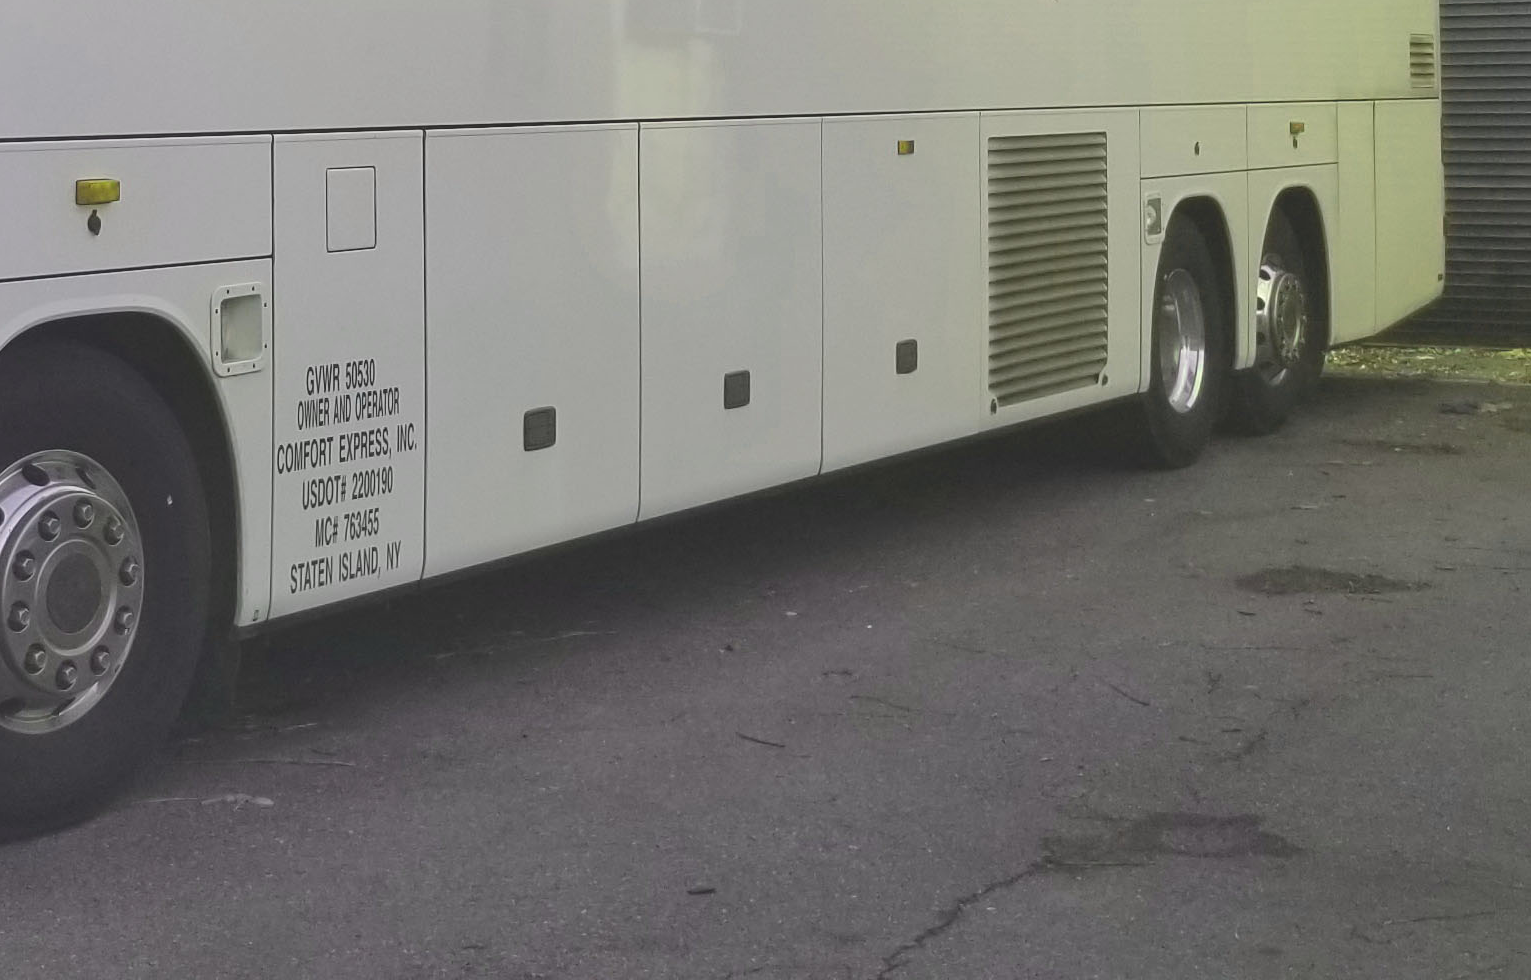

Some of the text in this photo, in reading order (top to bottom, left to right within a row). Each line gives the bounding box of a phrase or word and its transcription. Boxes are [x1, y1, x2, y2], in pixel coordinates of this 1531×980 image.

[306, 358, 375, 396] GVWR 50530
[297, 386, 400, 431] OWNER AND OPERATOR
[276, 422, 418, 475] COMFORT EXPRESS, INC.
[302, 465, 394, 510] USDOT# 2200190
[314, 507, 380, 548] MC# 763455
[289, 539, 402, 595] STATEN ISLAND, NY
